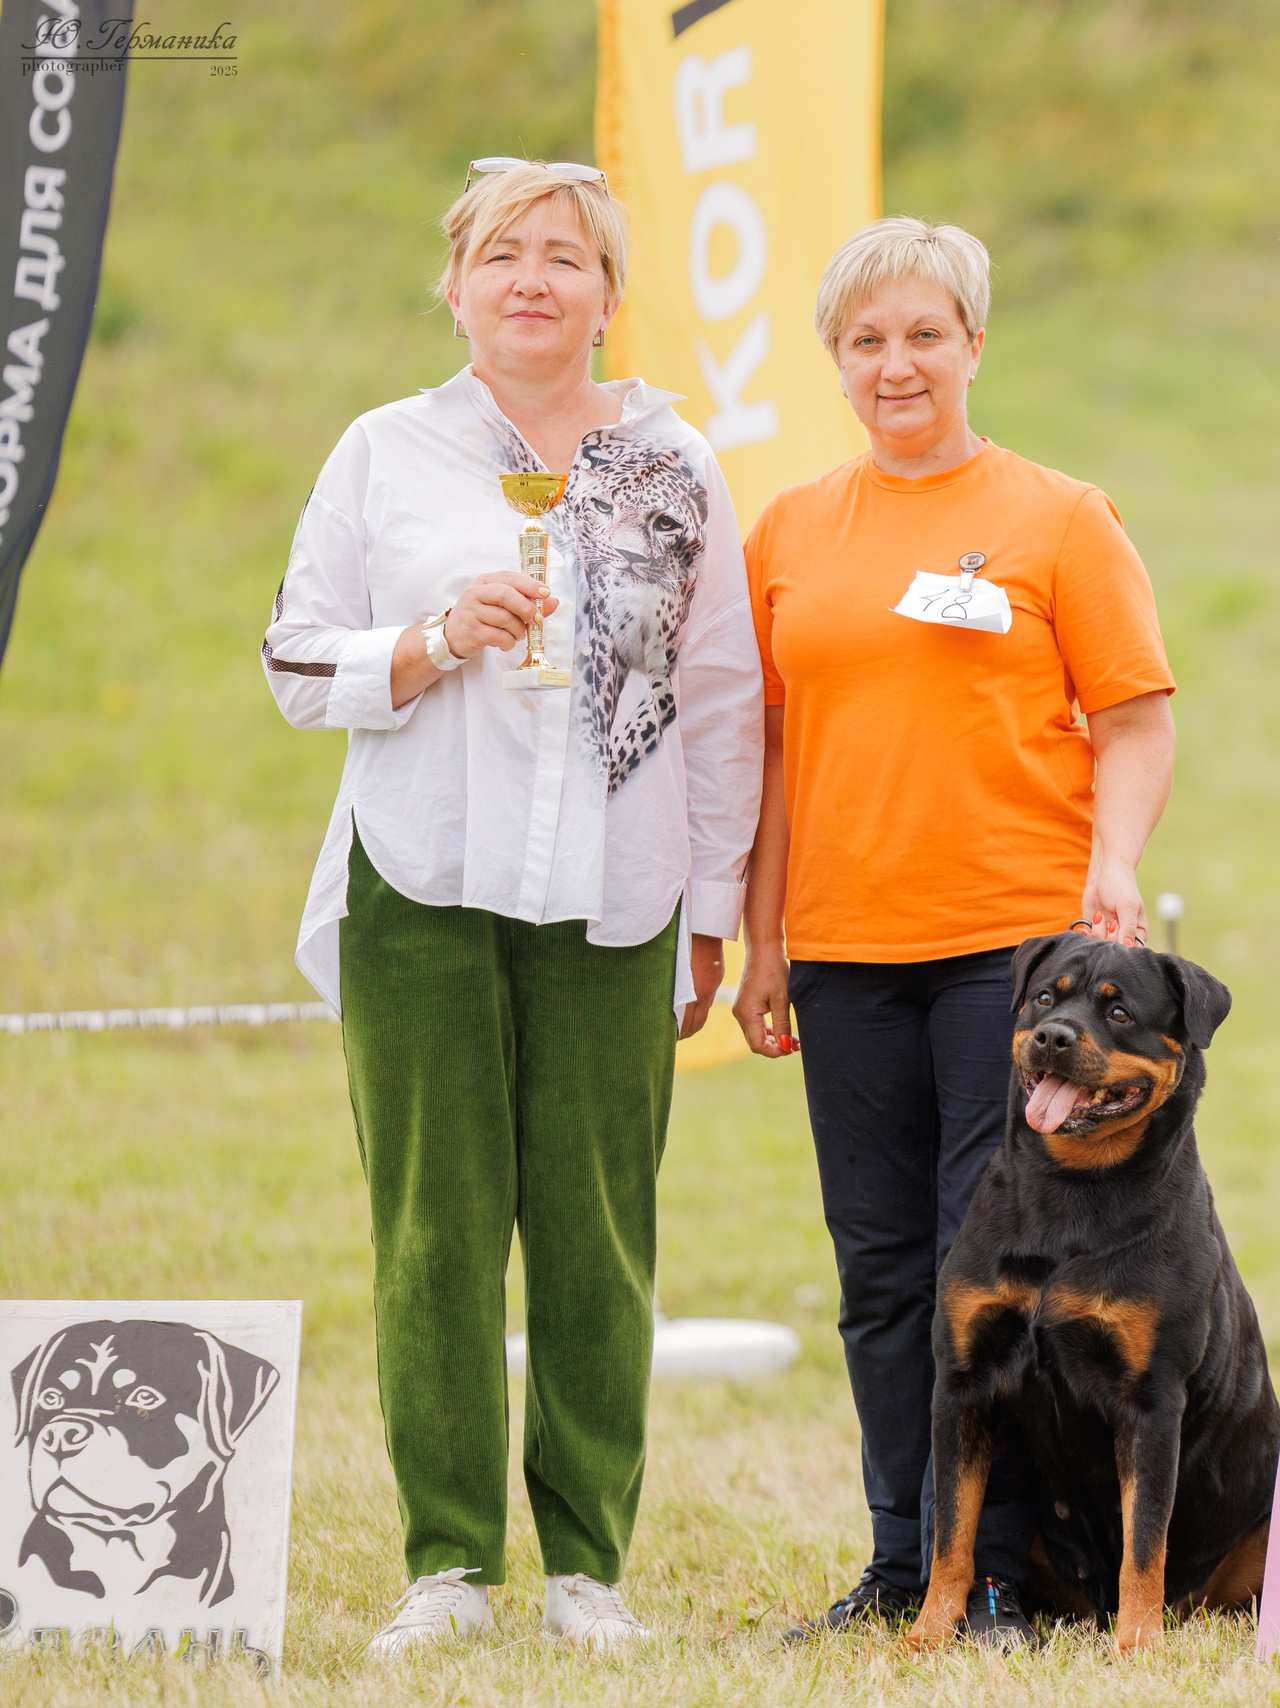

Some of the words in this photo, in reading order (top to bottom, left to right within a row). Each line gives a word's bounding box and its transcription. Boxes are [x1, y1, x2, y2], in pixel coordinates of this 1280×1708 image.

[14, 165, 66, 312] ДЛЯ
[670, 0, 780, 453] KOR
[0, 319, 50, 556] ОРМА
